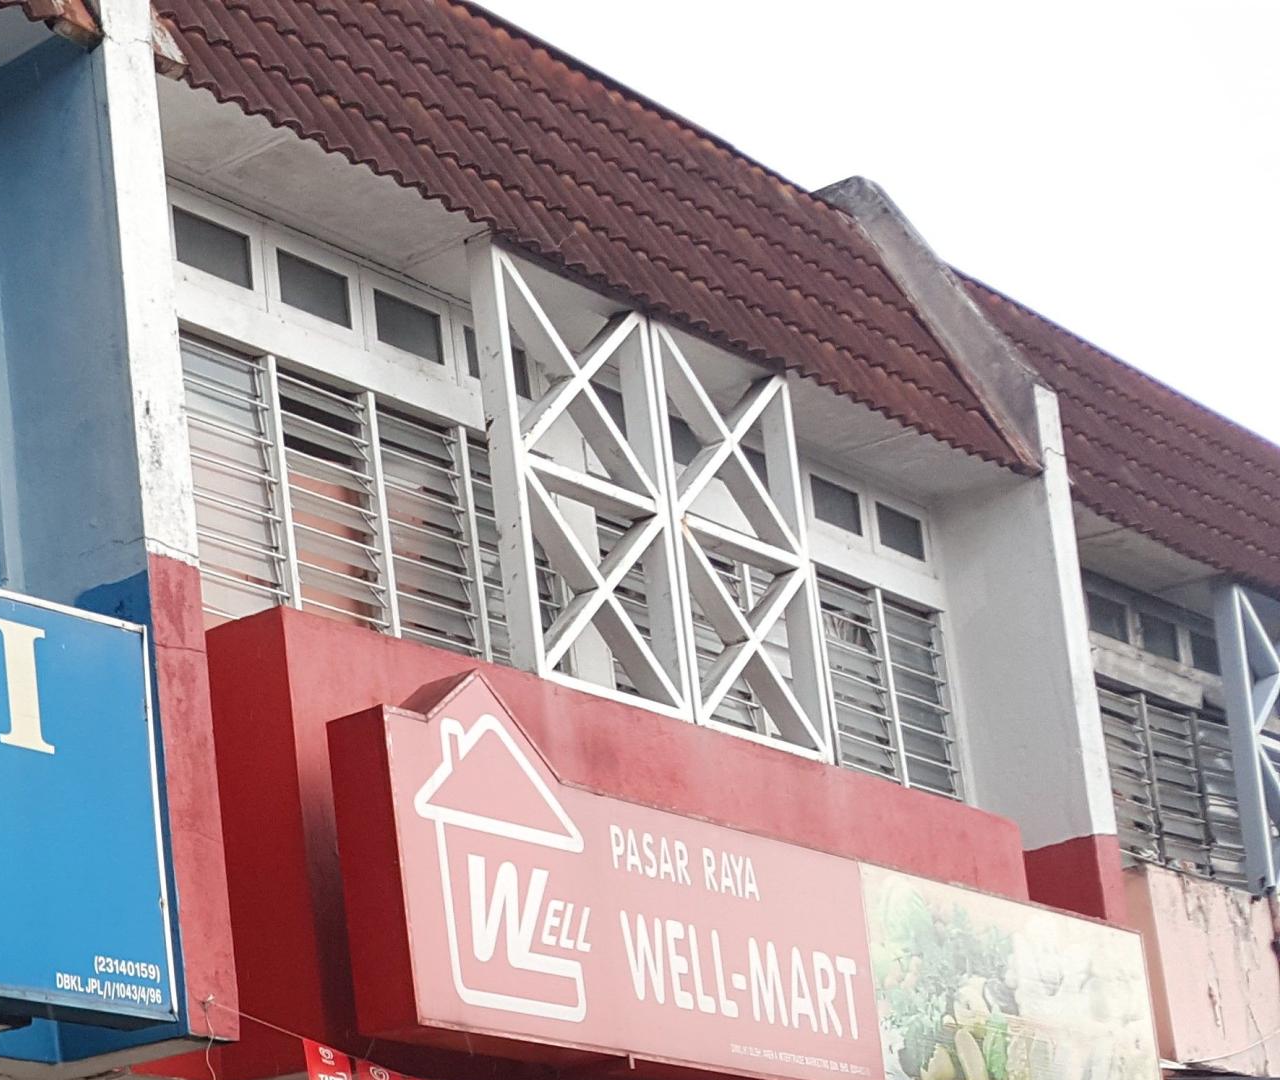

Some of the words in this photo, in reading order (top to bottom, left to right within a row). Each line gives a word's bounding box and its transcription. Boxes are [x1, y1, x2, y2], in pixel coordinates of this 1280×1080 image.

[609, 825, 692, 886] PASAR
[704, 847, 760, 902] RAYA
[56, 972, 85, 993] DBKL
[94, 955, 161, 984] (23140159)
[619, 909, 859, 1041] WELL-MART
